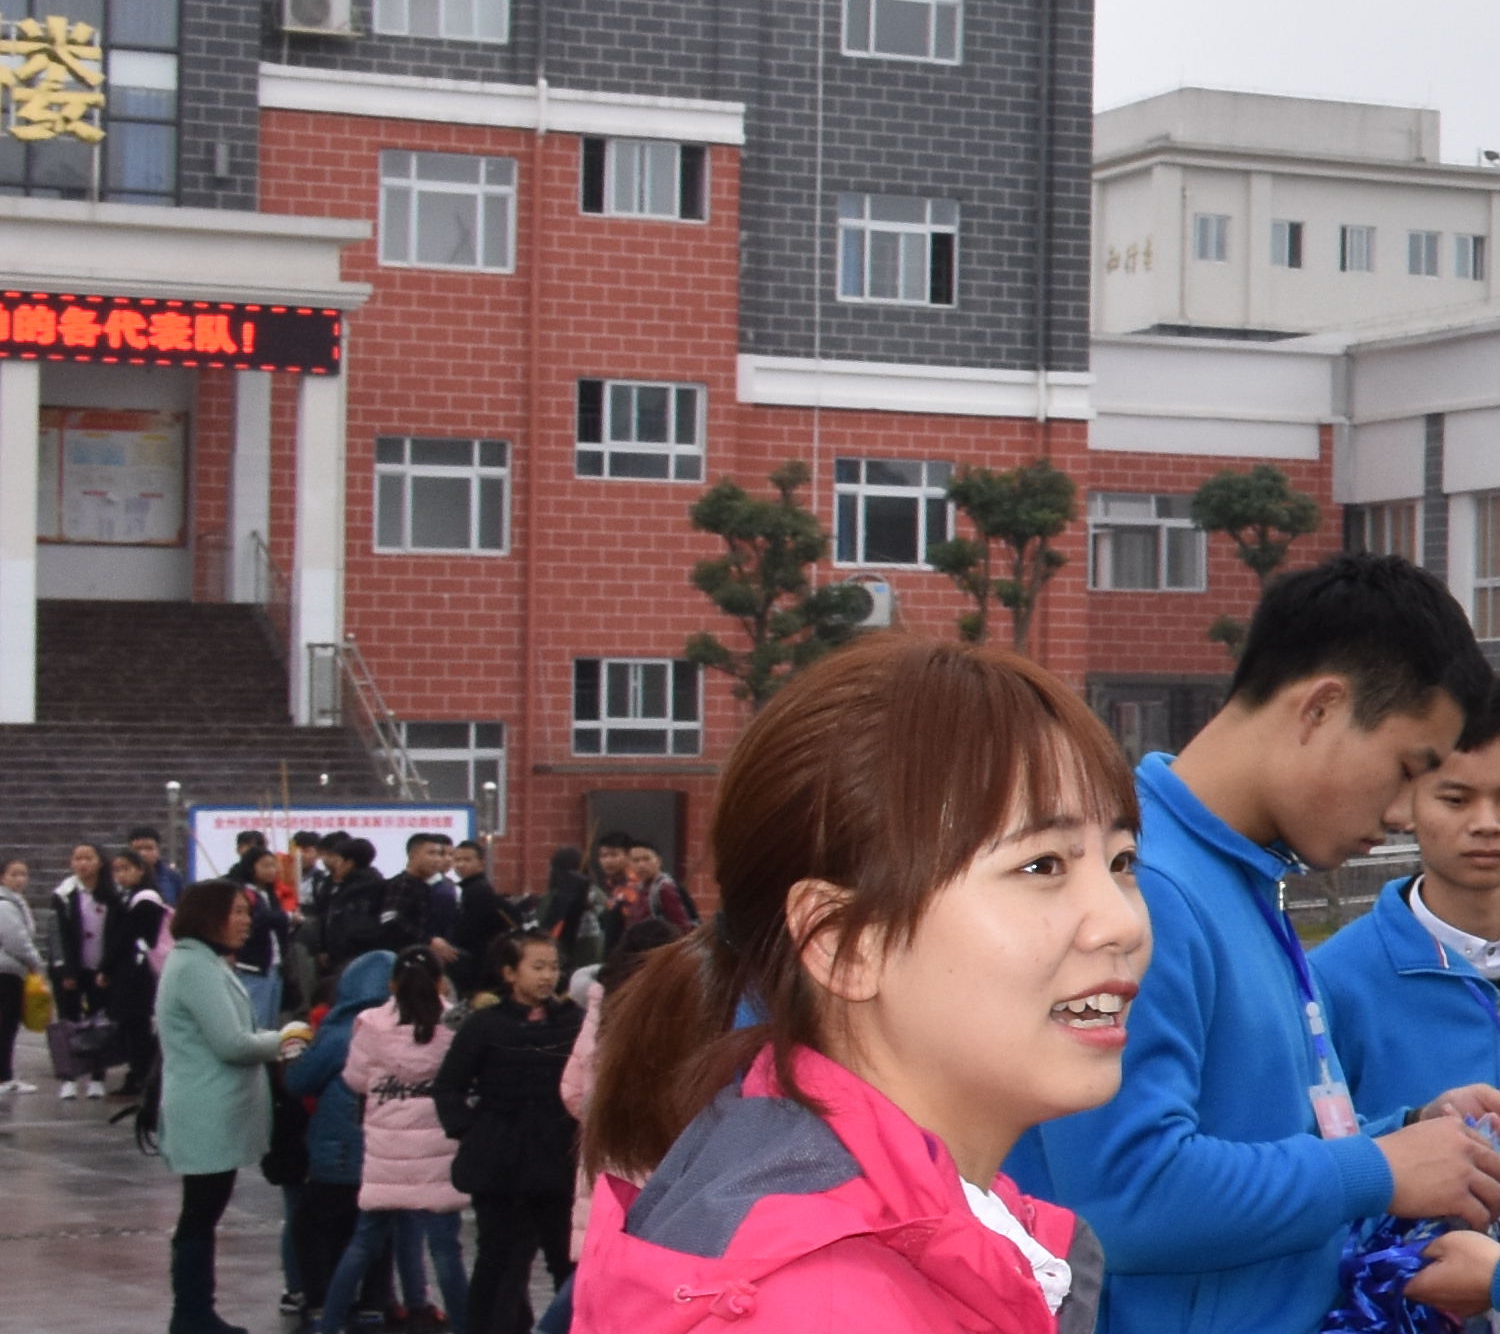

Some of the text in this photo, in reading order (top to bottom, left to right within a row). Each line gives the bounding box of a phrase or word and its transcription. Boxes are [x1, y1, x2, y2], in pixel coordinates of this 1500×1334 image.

[0, 303, 255, 355] 的各代表队!
